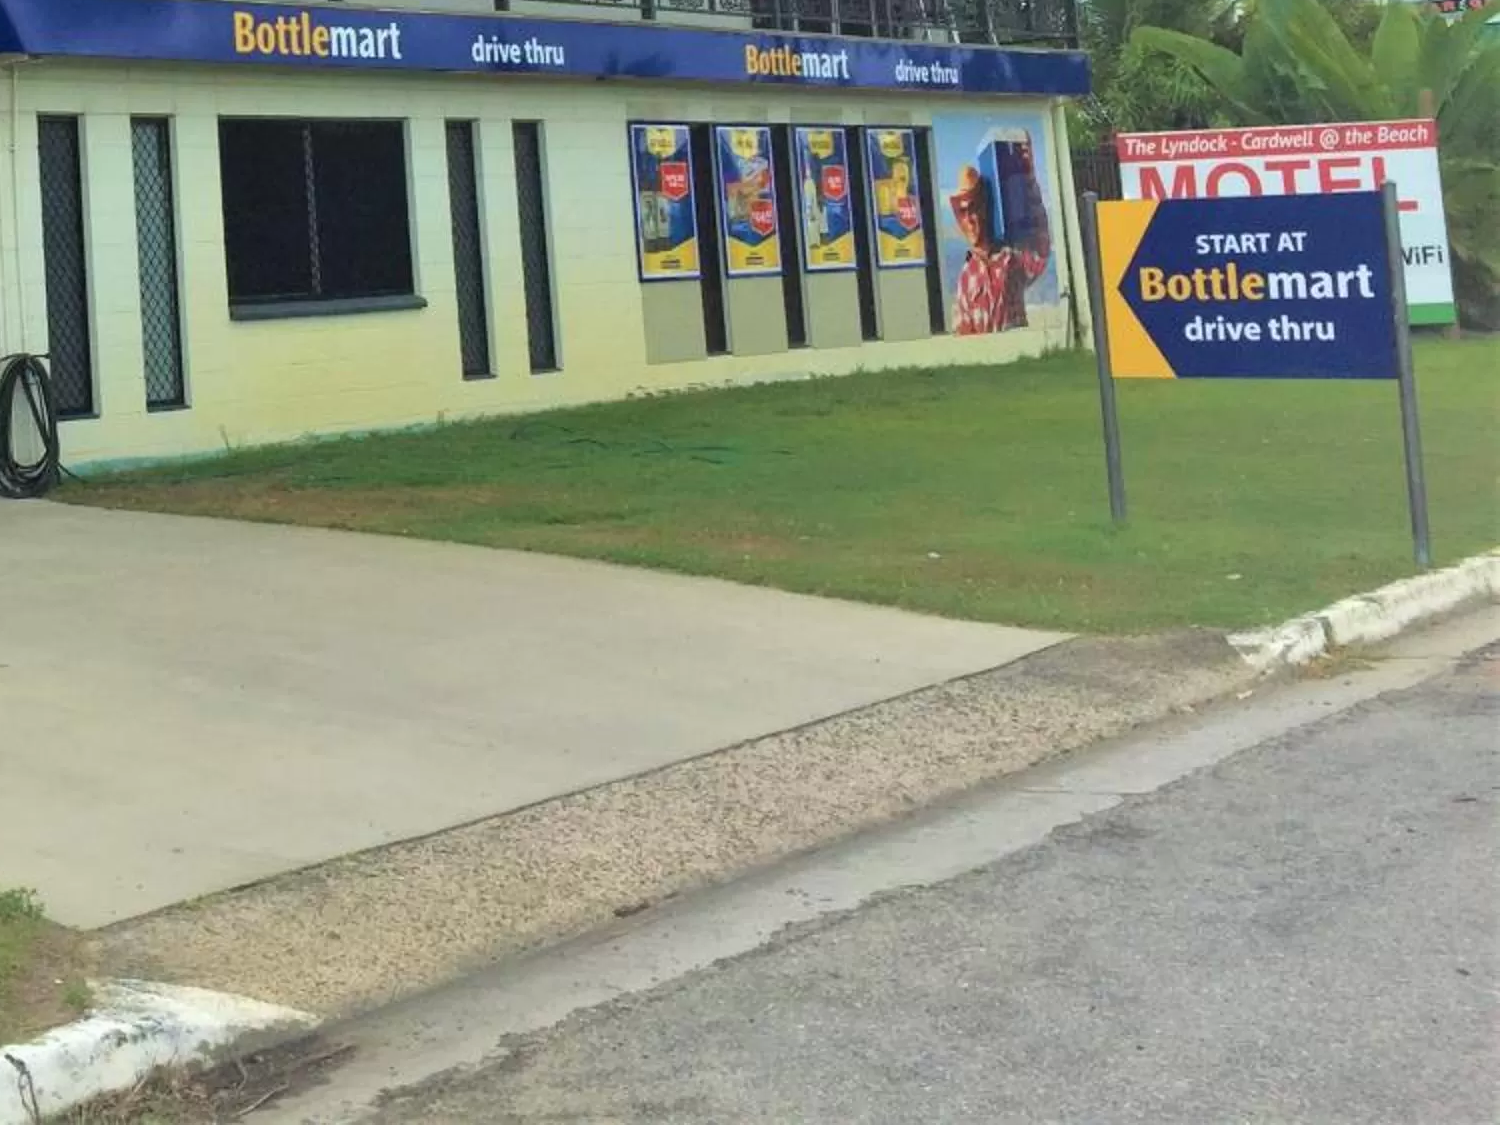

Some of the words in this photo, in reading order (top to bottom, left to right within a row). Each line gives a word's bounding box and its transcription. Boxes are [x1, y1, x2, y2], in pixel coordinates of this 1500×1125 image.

[233, 10, 402, 60] Bottlemart
[471, 34, 521, 65] drive
[524, 38, 565, 66] thru
[744, 44, 850, 79] Bottlemart
[895, 59, 929, 83] drive
[931, 61, 959, 84] thru
[1125, 138, 1156, 155] The
[1161, 135, 1228, 158] Lyndock
[1241, 130, 1314, 150] Cardwell
[1320, 129, 1340, 150] @
[1345, 127, 1372, 145] the
[1378, 124, 1429, 143] Beach
[1139, 156, 1418, 211] MOTEL
[1195, 232, 1271, 254] START
[1277, 231, 1307, 252] AT
[1139, 262, 1375, 302] Bottlemart
[1185, 315, 1261, 341] drive
[1268, 315, 1335, 341] thru
